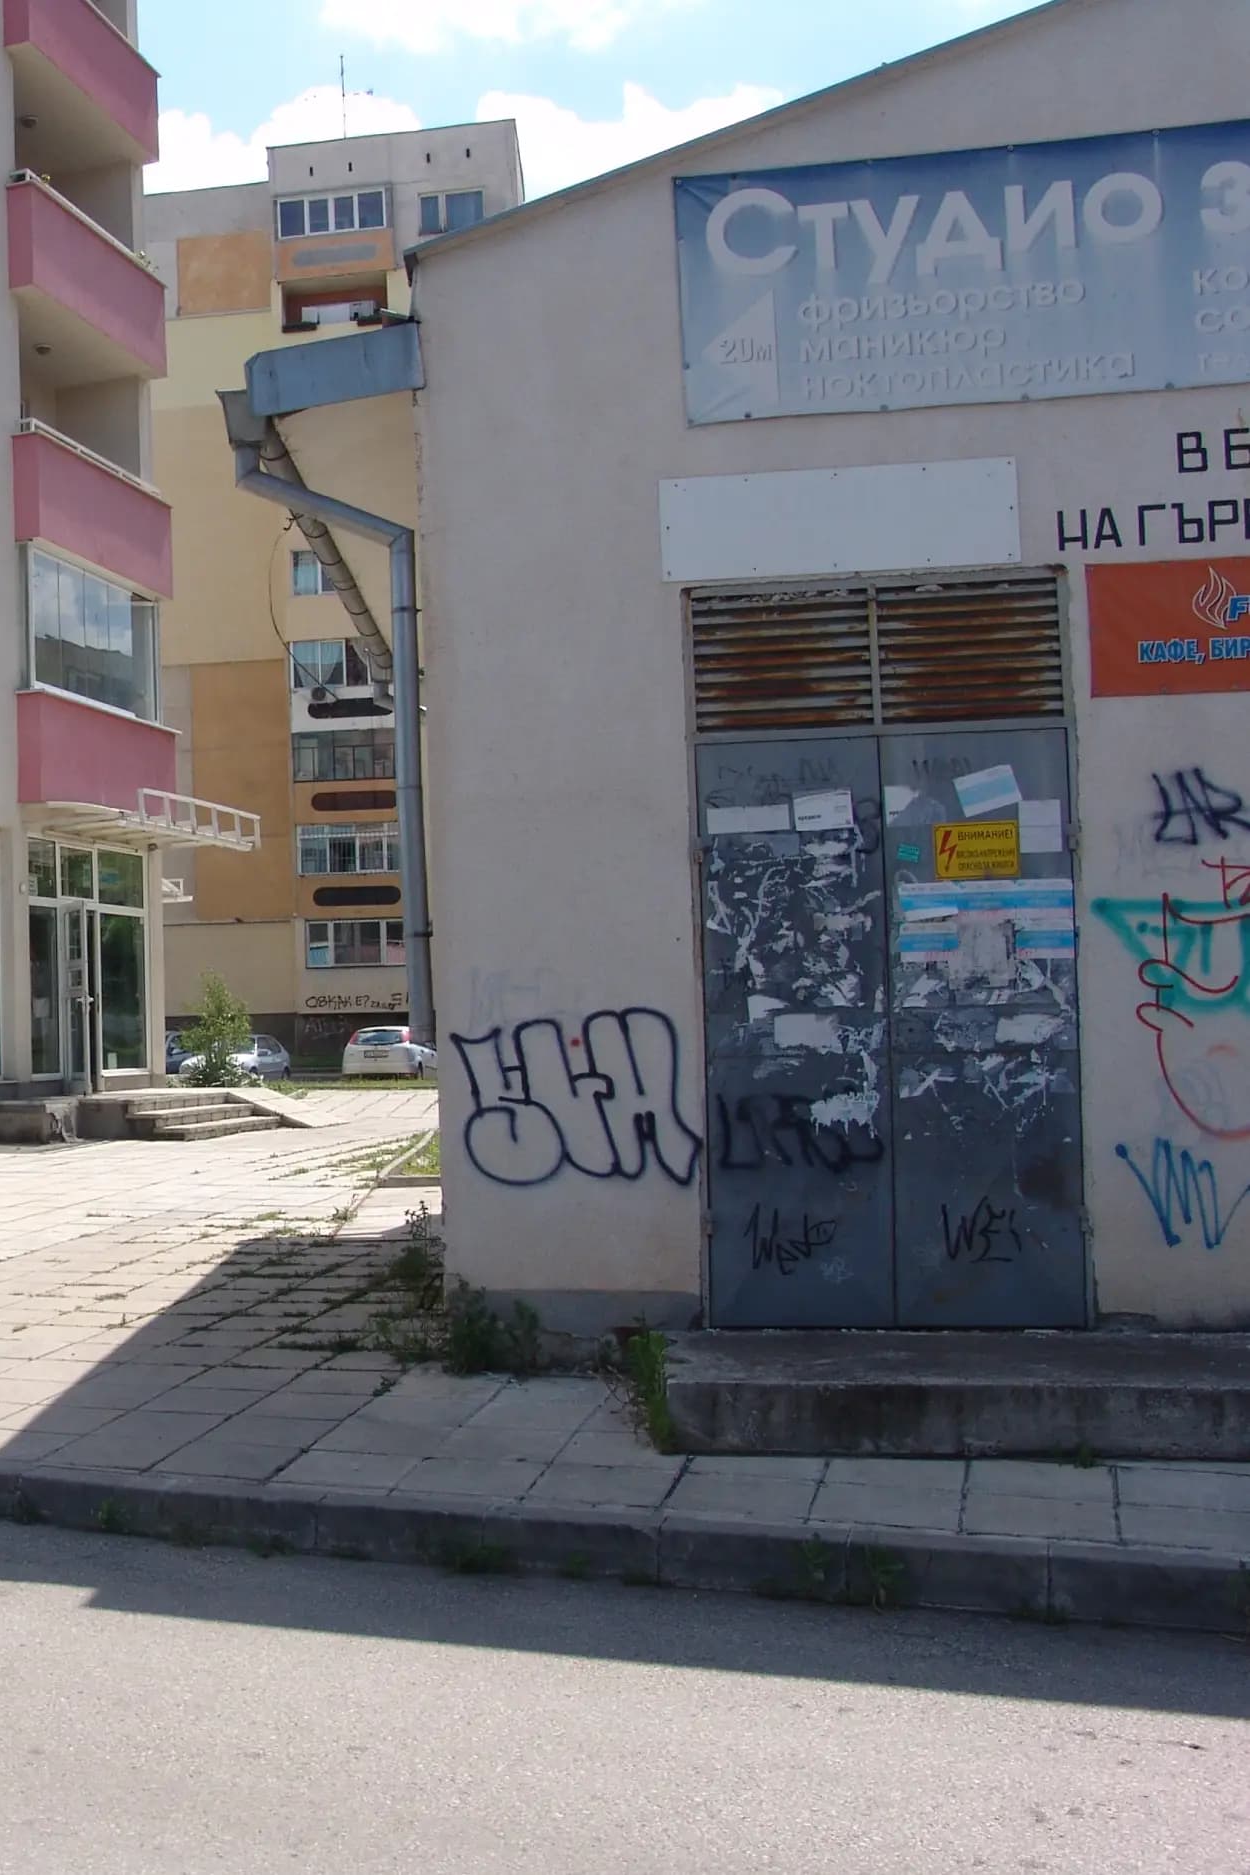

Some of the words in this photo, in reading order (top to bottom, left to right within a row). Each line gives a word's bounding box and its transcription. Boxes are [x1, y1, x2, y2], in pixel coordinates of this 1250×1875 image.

[802, 327, 1006, 363] маникюр
[1057, 508, 1122, 551] НА
[1138, 498, 1250, 546] ГЪР
[957, 829, 1013, 841] ВНИМАНИЕ!
